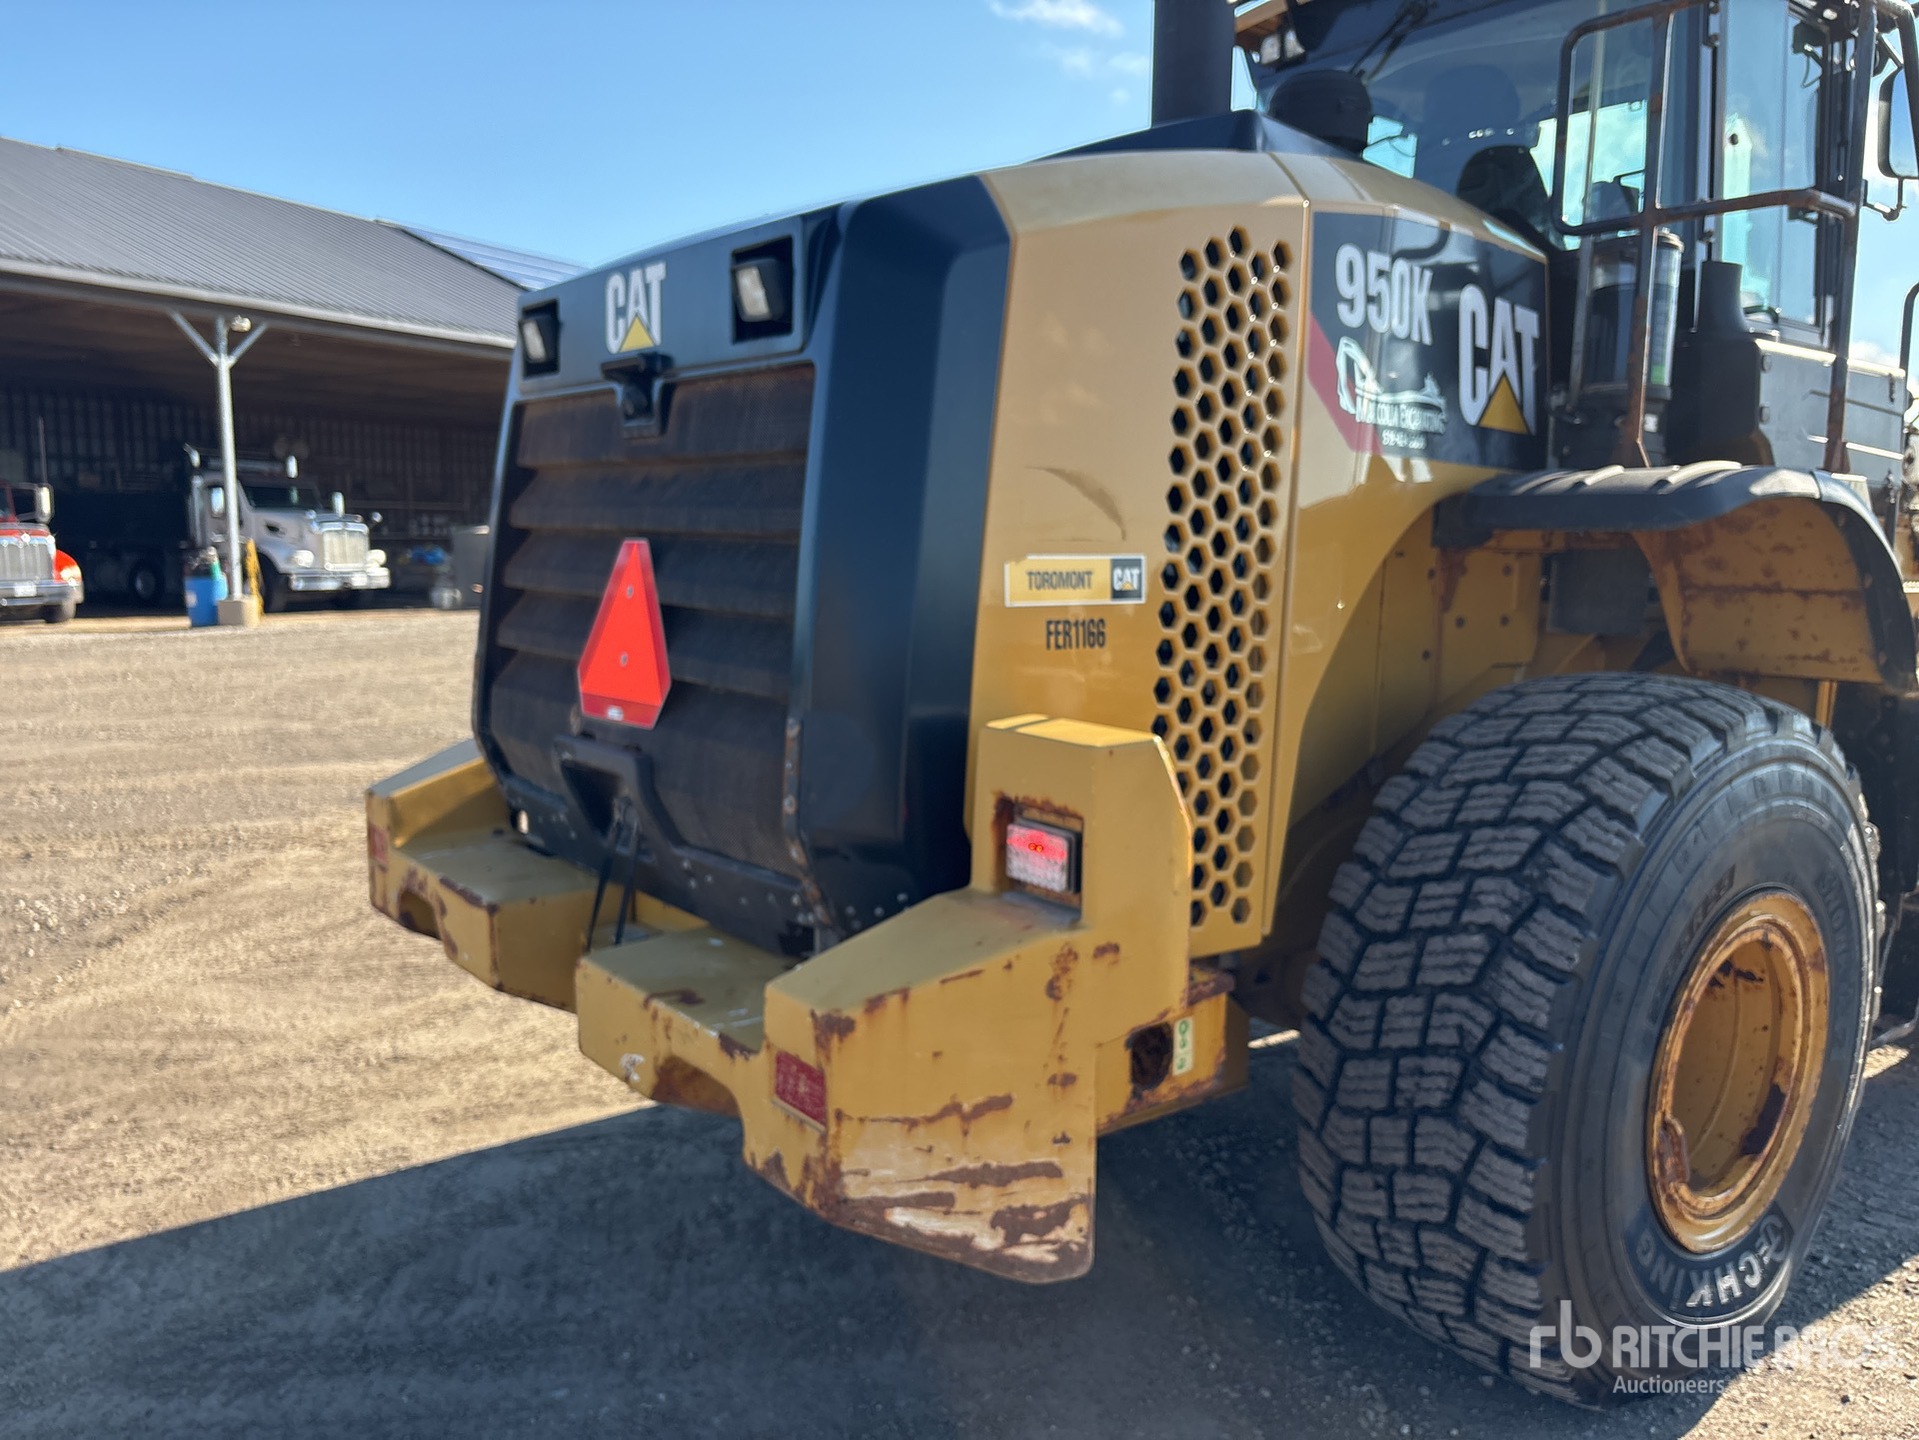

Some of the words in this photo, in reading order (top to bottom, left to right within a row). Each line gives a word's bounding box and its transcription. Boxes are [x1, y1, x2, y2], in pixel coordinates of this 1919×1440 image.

[605, 261, 666, 354] CAT
[1335, 242, 1434, 346] 950K
[1458, 283, 1540, 436] CAT
[1027, 570, 1093, 591] TOROMONT
[1113, 566, 1141, 591] CAT
[1046, 618, 1106, 651] FER1166
